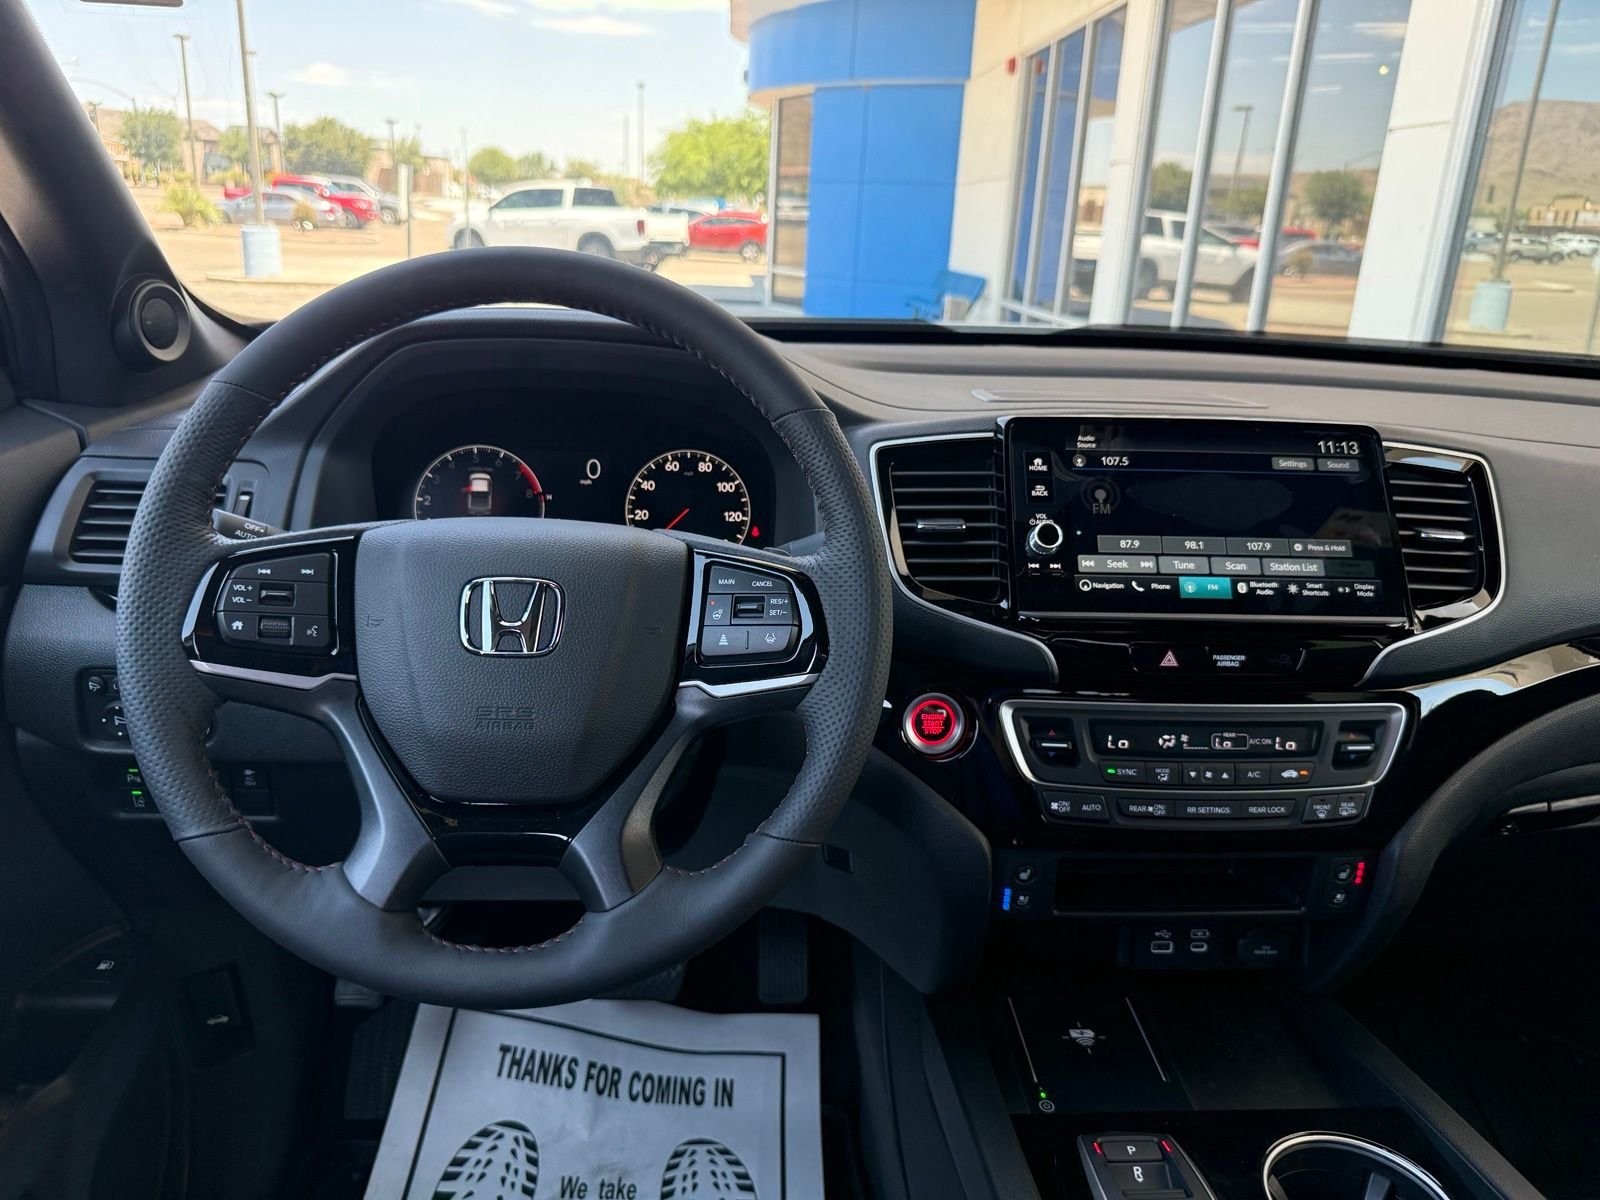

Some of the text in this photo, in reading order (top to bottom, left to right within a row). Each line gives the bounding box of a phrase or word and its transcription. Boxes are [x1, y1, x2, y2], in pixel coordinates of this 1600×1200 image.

[1317, 440, 1359, 455] 11:13
[664, 460, 680, 472] 60
[1100, 456, 1129, 466] 107.5
[1278, 459, 1307, 469] Settings
[1326, 461, 1350, 469] Sound
[586, 458, 601, 479] 0
[697, 461, 713, 473] 80
[640, 480, 656, 491] 40
[716, 482, 736, 492] 100
[423, 495, 432, 506] 2
[1092, 503, 1111, 514] FM
[634, 509, 649, 520] 20
[724, 511, 742, 522] 120
[244, 522, 261, 532] OFF
[1119, 539, 1140, 549] 87.9
[1184, 541, 1204, 550] 98.1
[1246, 542, 1271, 551] 107.9
[1307, 544, 1323, 552] Press
[1106, 560, 1129, 568] Seek
[1172, 560, 1196, 570] Tune
[1225, 561, 1247, 571] Scan
[1270, 563, 1318, 572] Station List
[1092, 582, 1125, 590] Navigation
[1353, 583, 1375, 591] Display
[1107, 734, 1129, 749] Lo
[1215, 738, 1232, 748] Lo
[1275, 737, 1297, 750] Lo
[1116, 768, 1137, 776] SYNC
[1247, 771, 1261, 779] A/C
[1081, 804, 1101, 812] AUTO
[1128, 804, 1147, 813] REAR
[1187, 806, 1230, 815] RR SETTINGS
[1248, 805, 1286, 813] REAR LOCK
[497, 1044, 735, 1108] THANKS FOR COMING IN
[1127, 1145, 1136, 1155] P
[561, 1175, 637, 1200] We take
